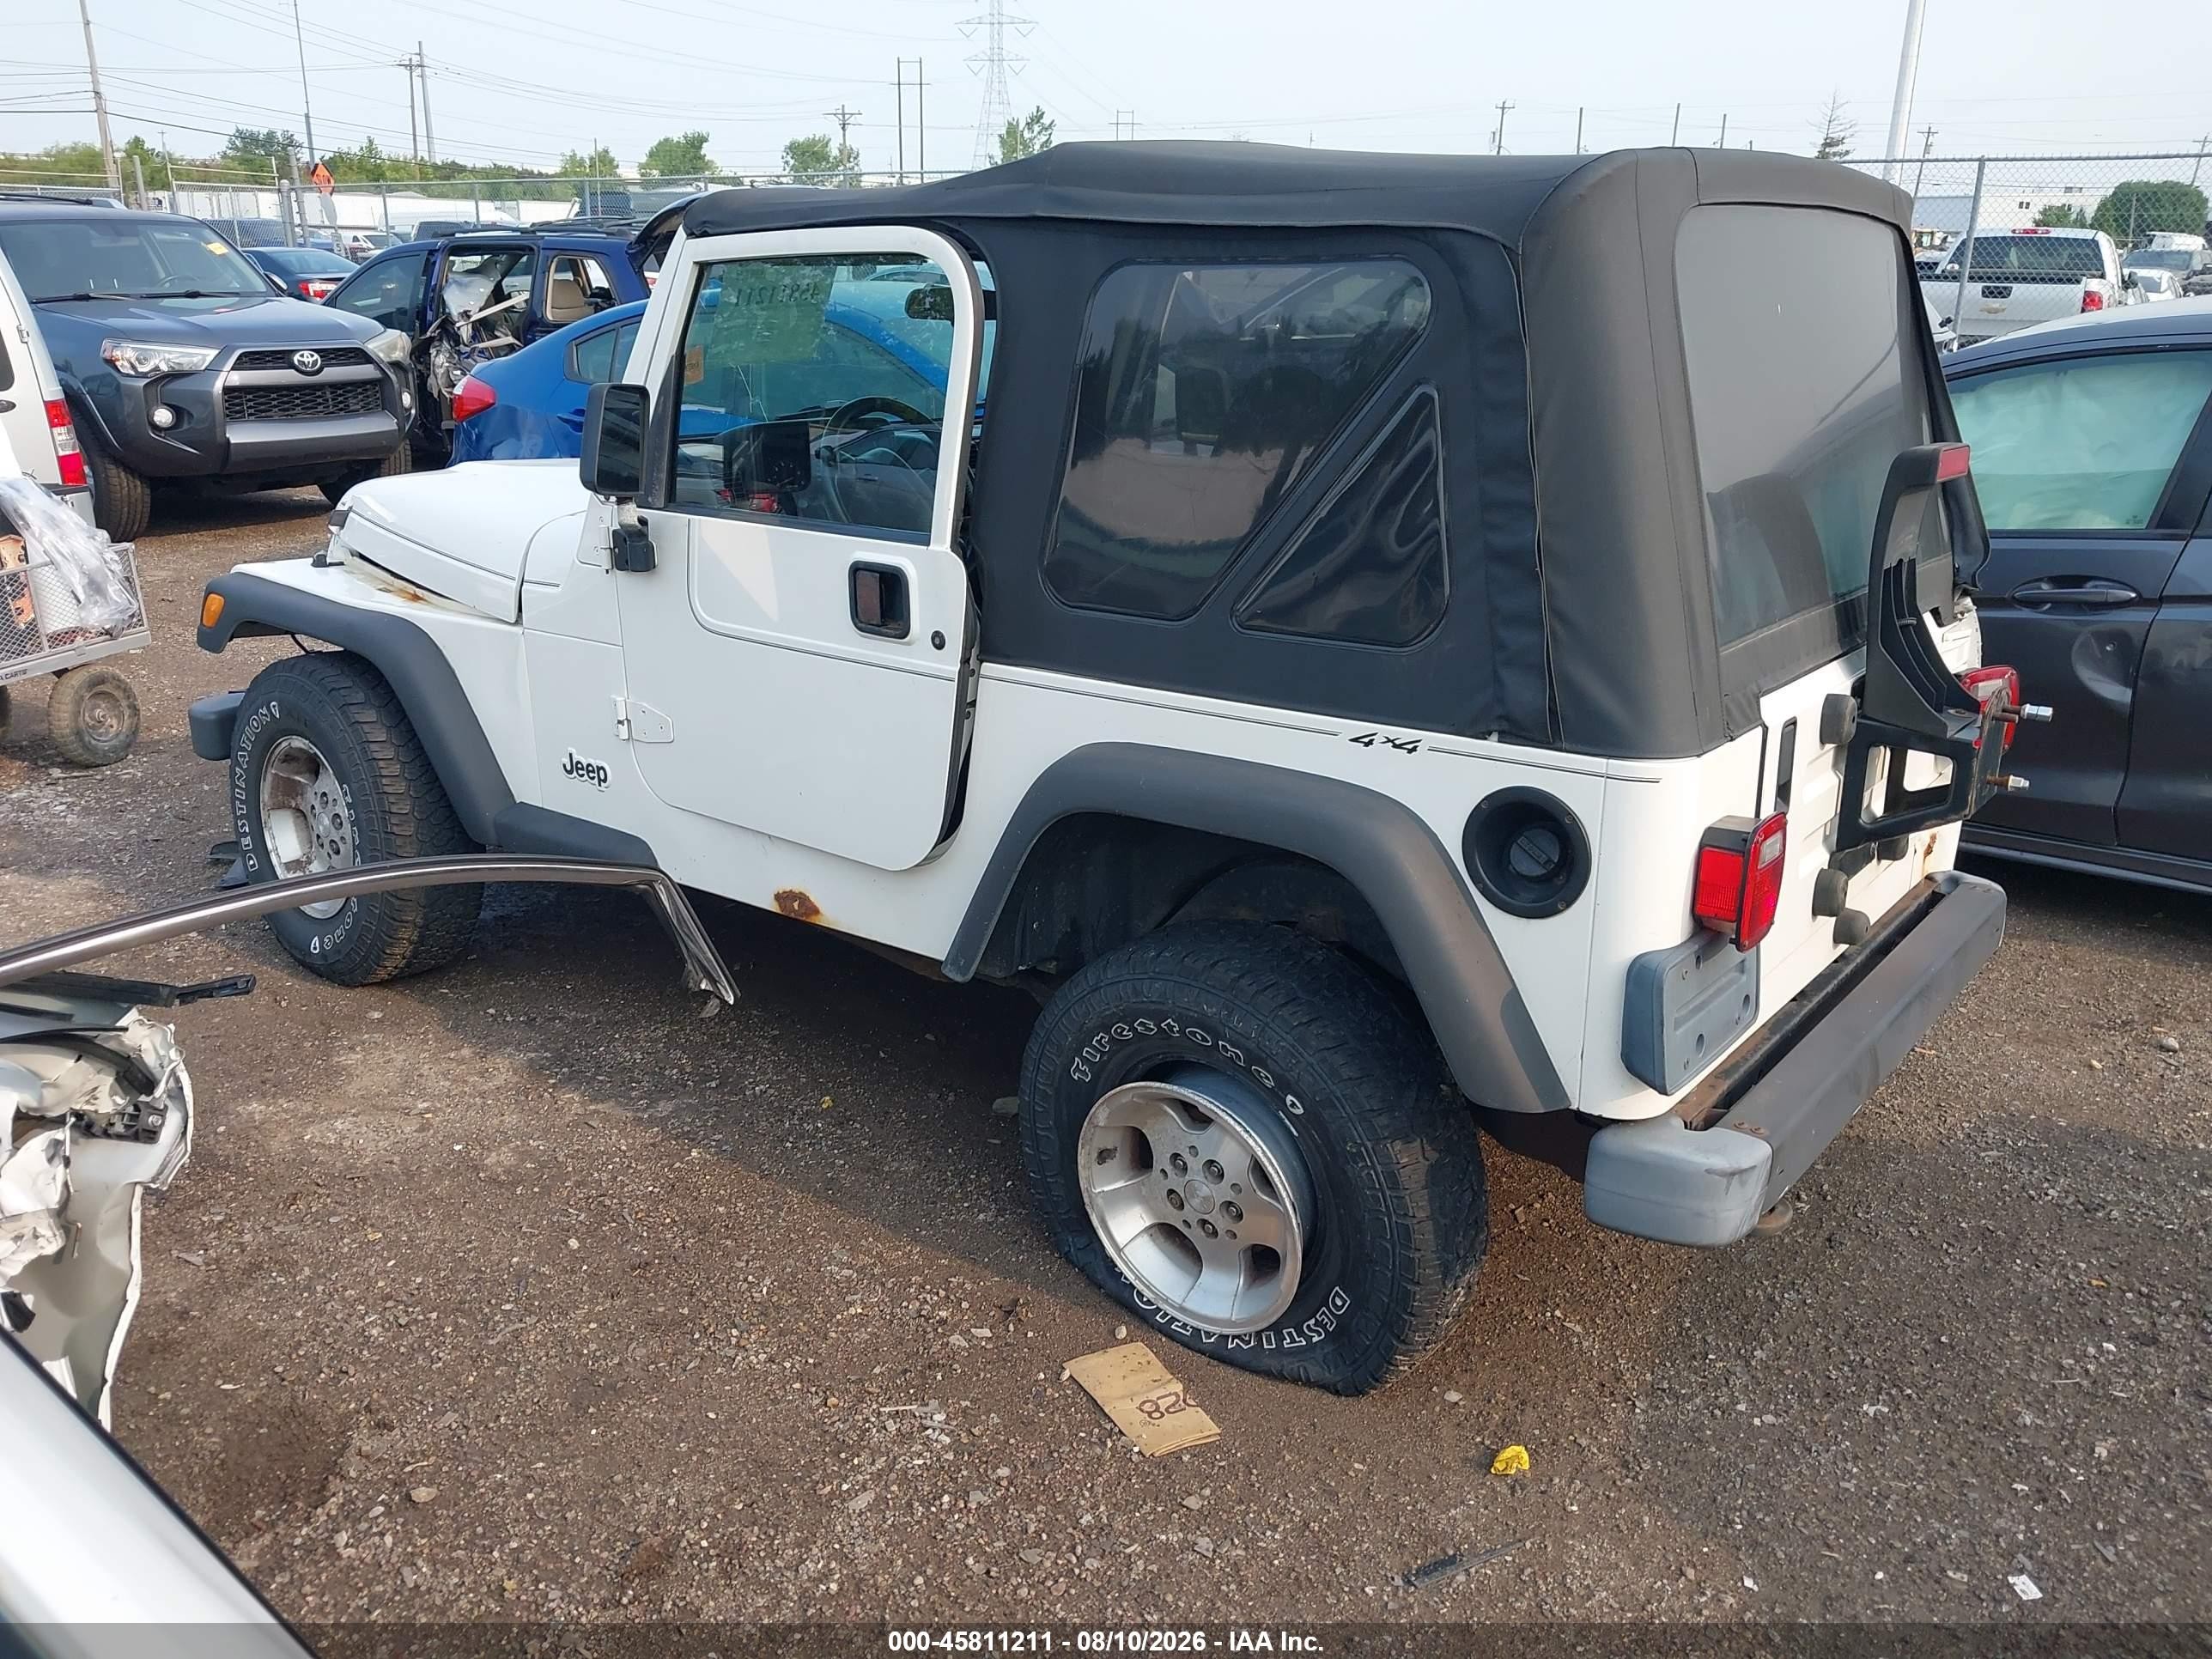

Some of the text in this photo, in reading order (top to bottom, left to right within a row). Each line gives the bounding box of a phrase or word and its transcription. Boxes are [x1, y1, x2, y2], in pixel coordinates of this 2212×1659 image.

[562, 752, 608, 787] Jeep
[1347, 732, 1423, 754] 4x4
[234, 705, 270, 872] DESTINATION
[1070, 1018, 1275, 1089] Firestone
